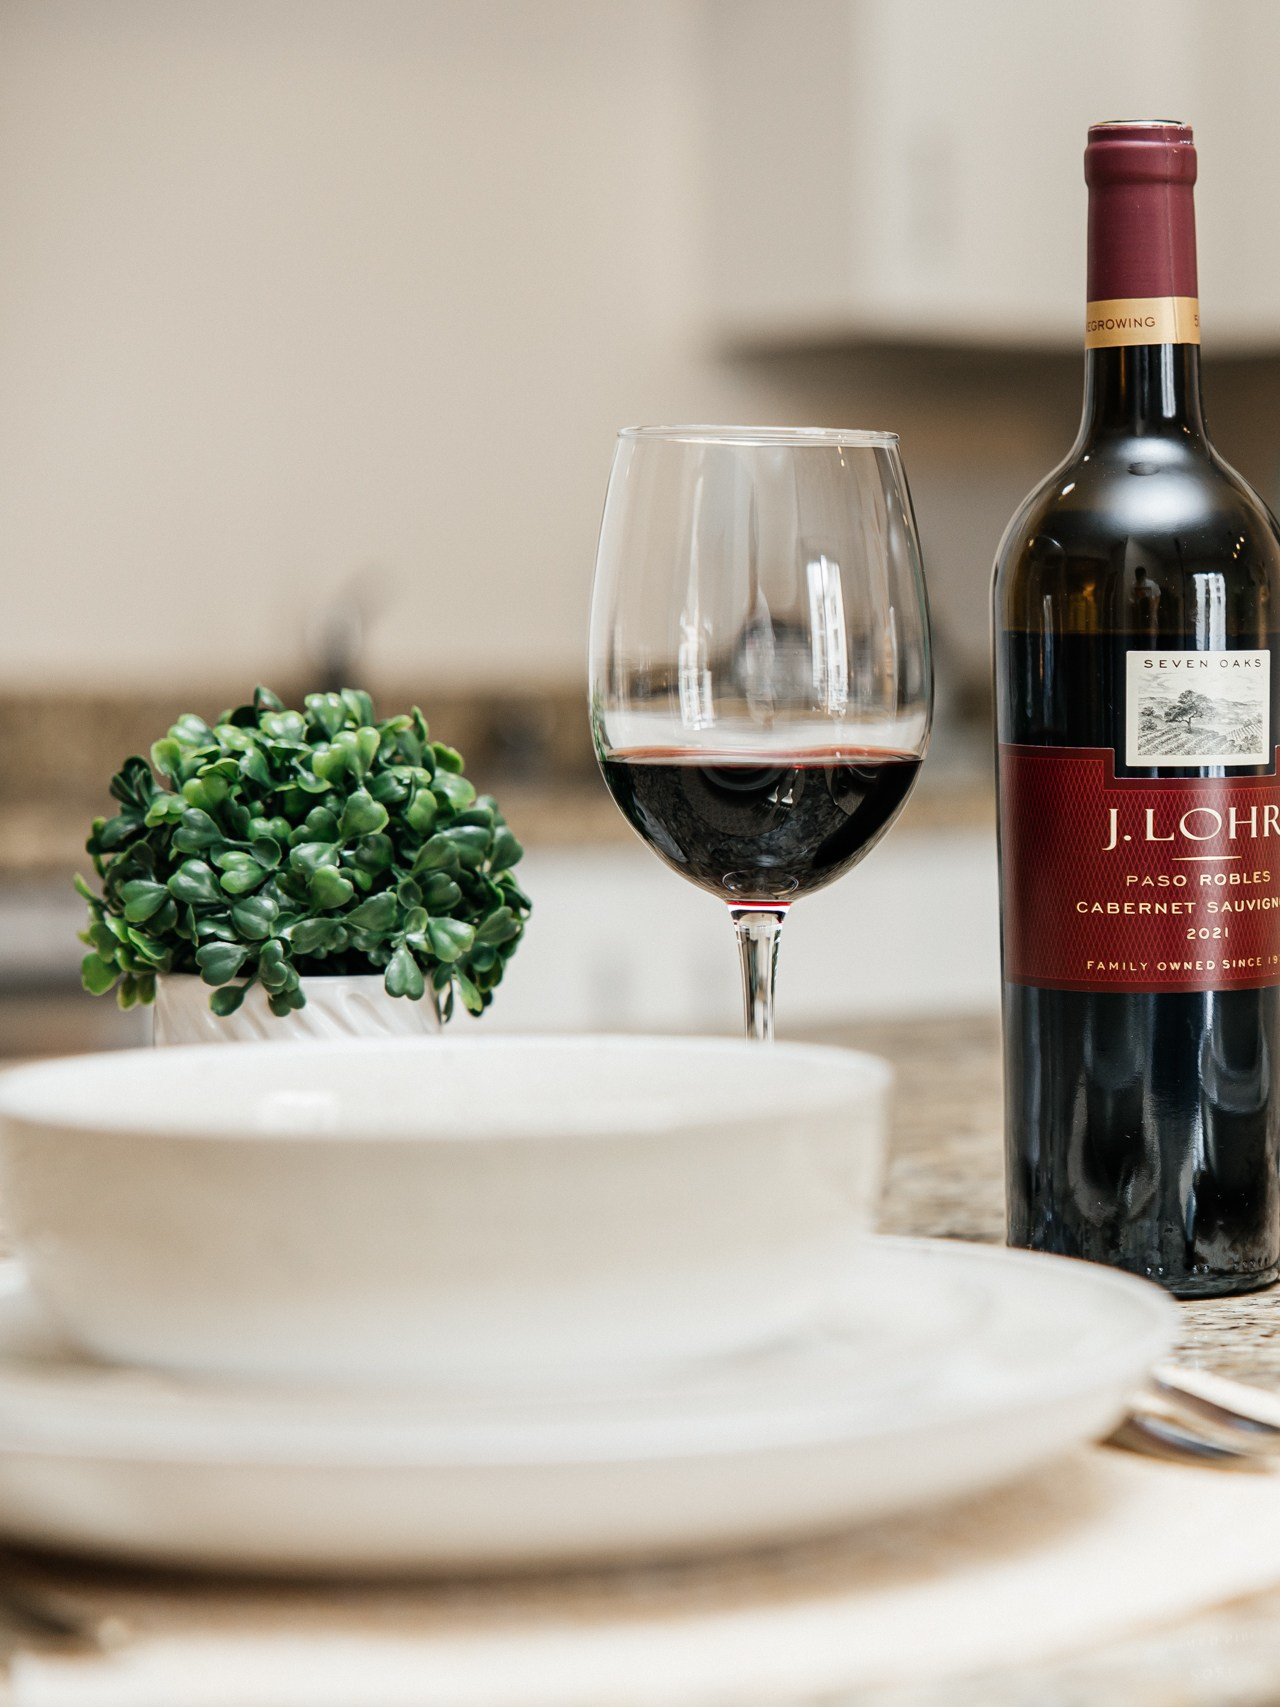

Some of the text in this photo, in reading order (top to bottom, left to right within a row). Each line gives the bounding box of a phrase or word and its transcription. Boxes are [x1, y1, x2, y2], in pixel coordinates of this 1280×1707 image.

[1143, 658, 1262, 669] SEVEN OAKS
[1102, 808, 1132, 851] J.
[1126, 870, 1272, 887] PASO ROBLES
[1076, 901, 1197, 915] CABERNET
[1186, 927, 1229, 940] 2021
[1086, 960, 1148, 971] FAMILY
[1156, 960, 1216, 971] OWNED
[1222, 957, 1262, 970] SINCE
